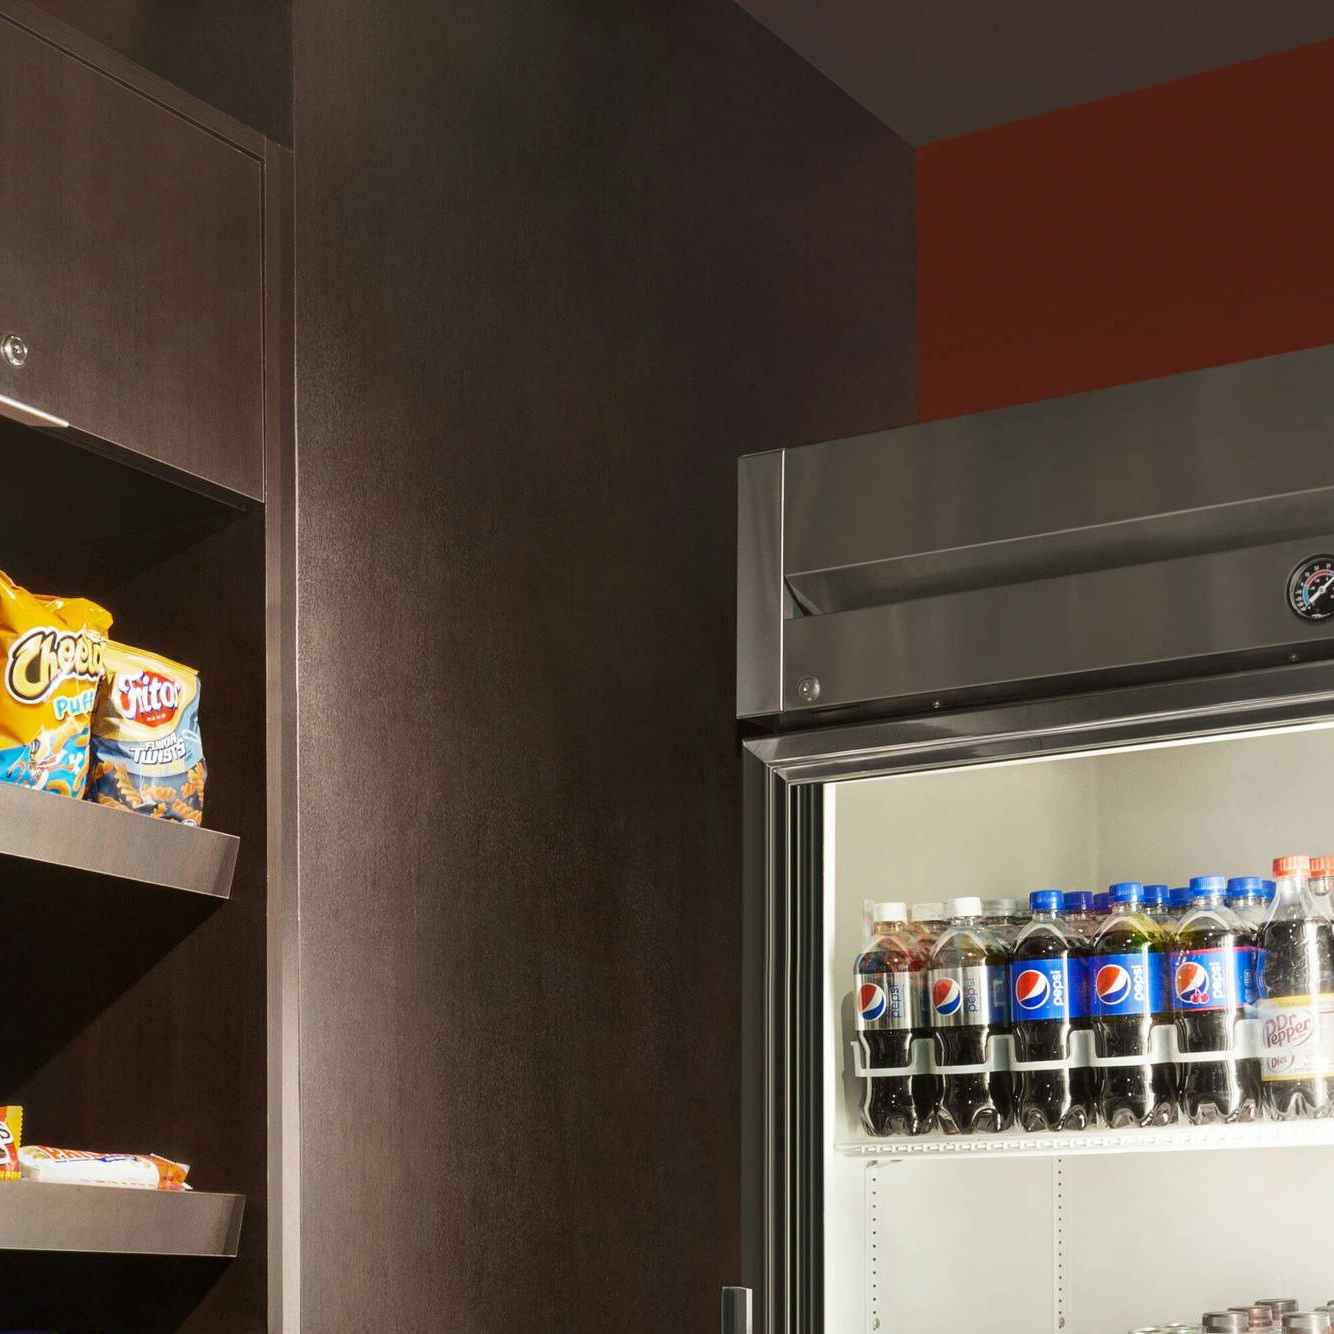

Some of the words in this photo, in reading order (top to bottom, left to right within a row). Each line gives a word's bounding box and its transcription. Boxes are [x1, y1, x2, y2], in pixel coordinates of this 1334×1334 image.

[131, 741, 186, 764] TWISTS
[1051, 969, 1064, 1007] pepsi
[1131, 964, 1144, 1002] pepsi
